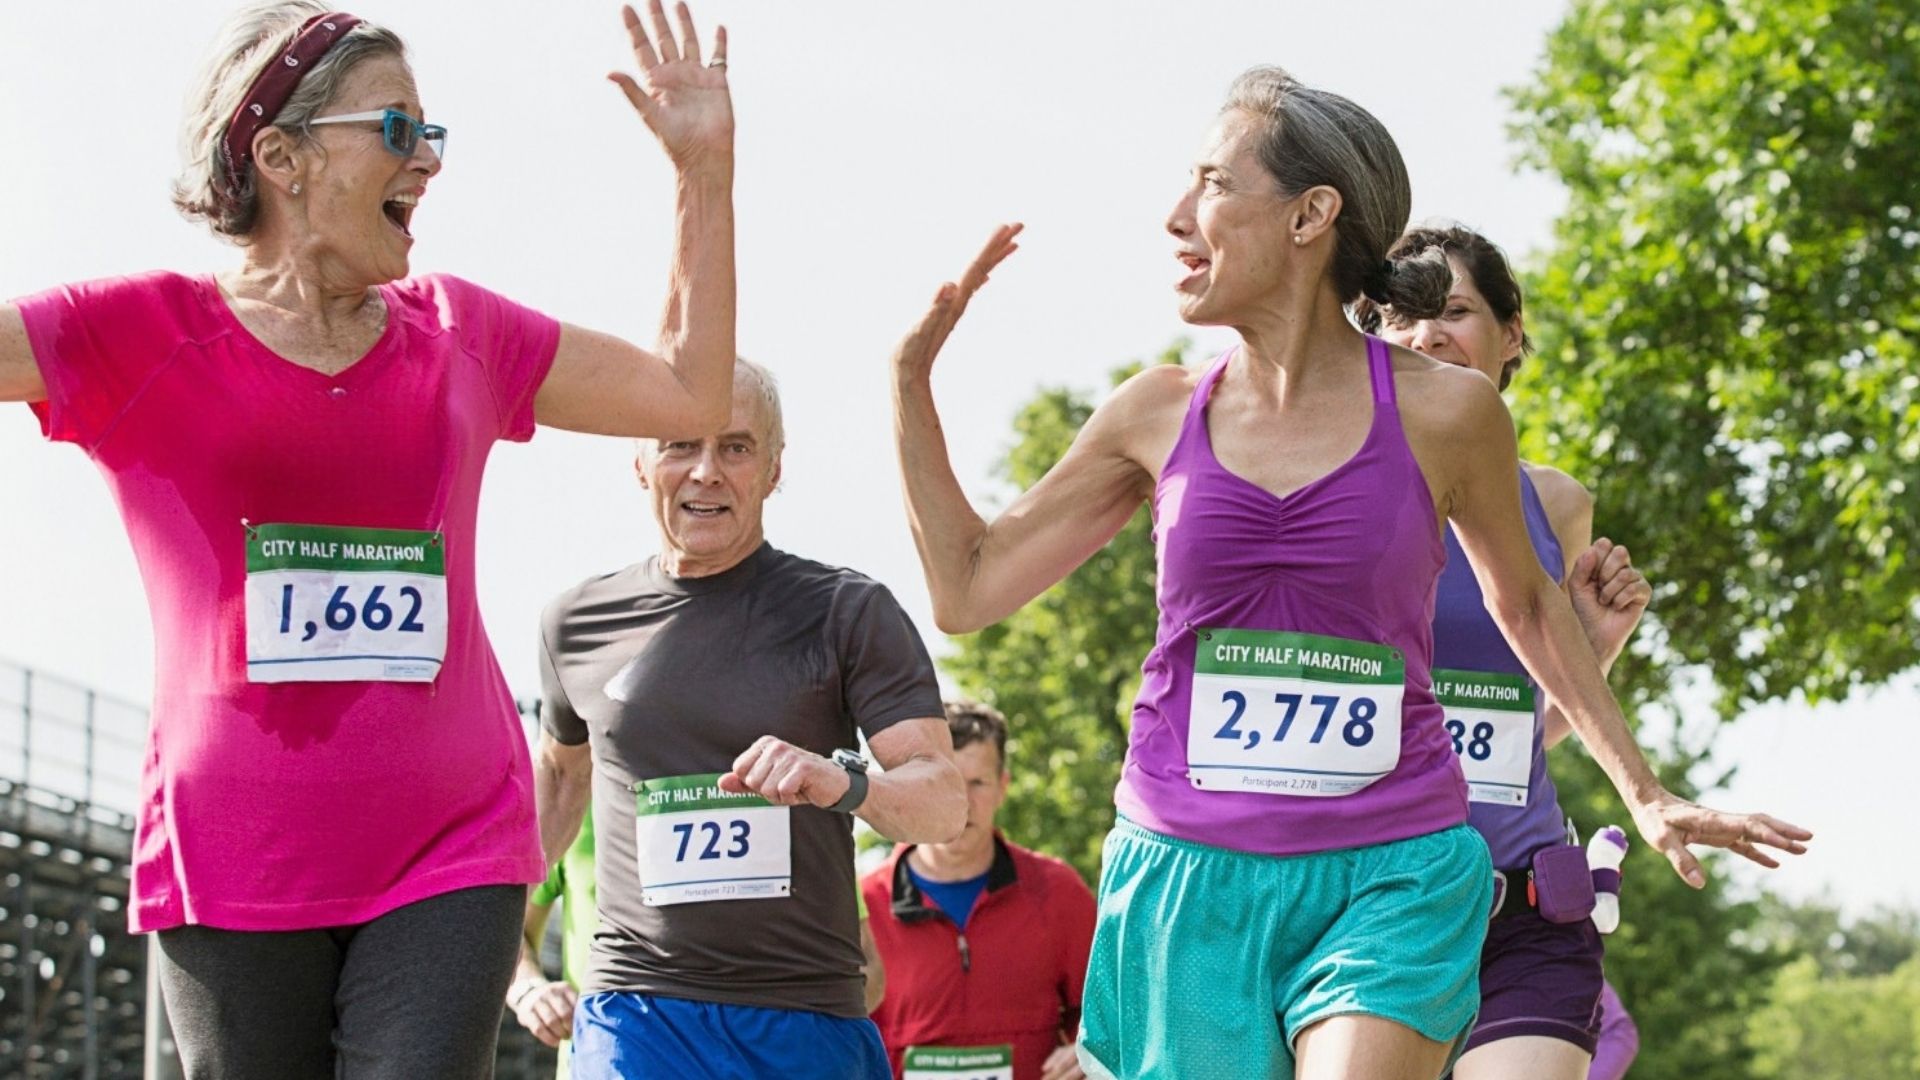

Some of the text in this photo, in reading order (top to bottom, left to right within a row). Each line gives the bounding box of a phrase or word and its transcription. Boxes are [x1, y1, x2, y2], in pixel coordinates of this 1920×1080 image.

[262, 540, 424, 562] CITY HALF MARATHON
[280, 583, 424, 642] 1,662
[1216, 645, 1382, 676] CITY HALF MARATHON
[1429, 682, 1519, 701] ALF MARATHON
[1213, 690, 1377, 750] 2,778
[1242, 776, 1288, 789] Participant
[1290, 779, 1318, 790] 2,778
[648, 790, 671, 806] CITY
[673, 787, 703, 802] HALF
[673, 819, 751, 863] 723
